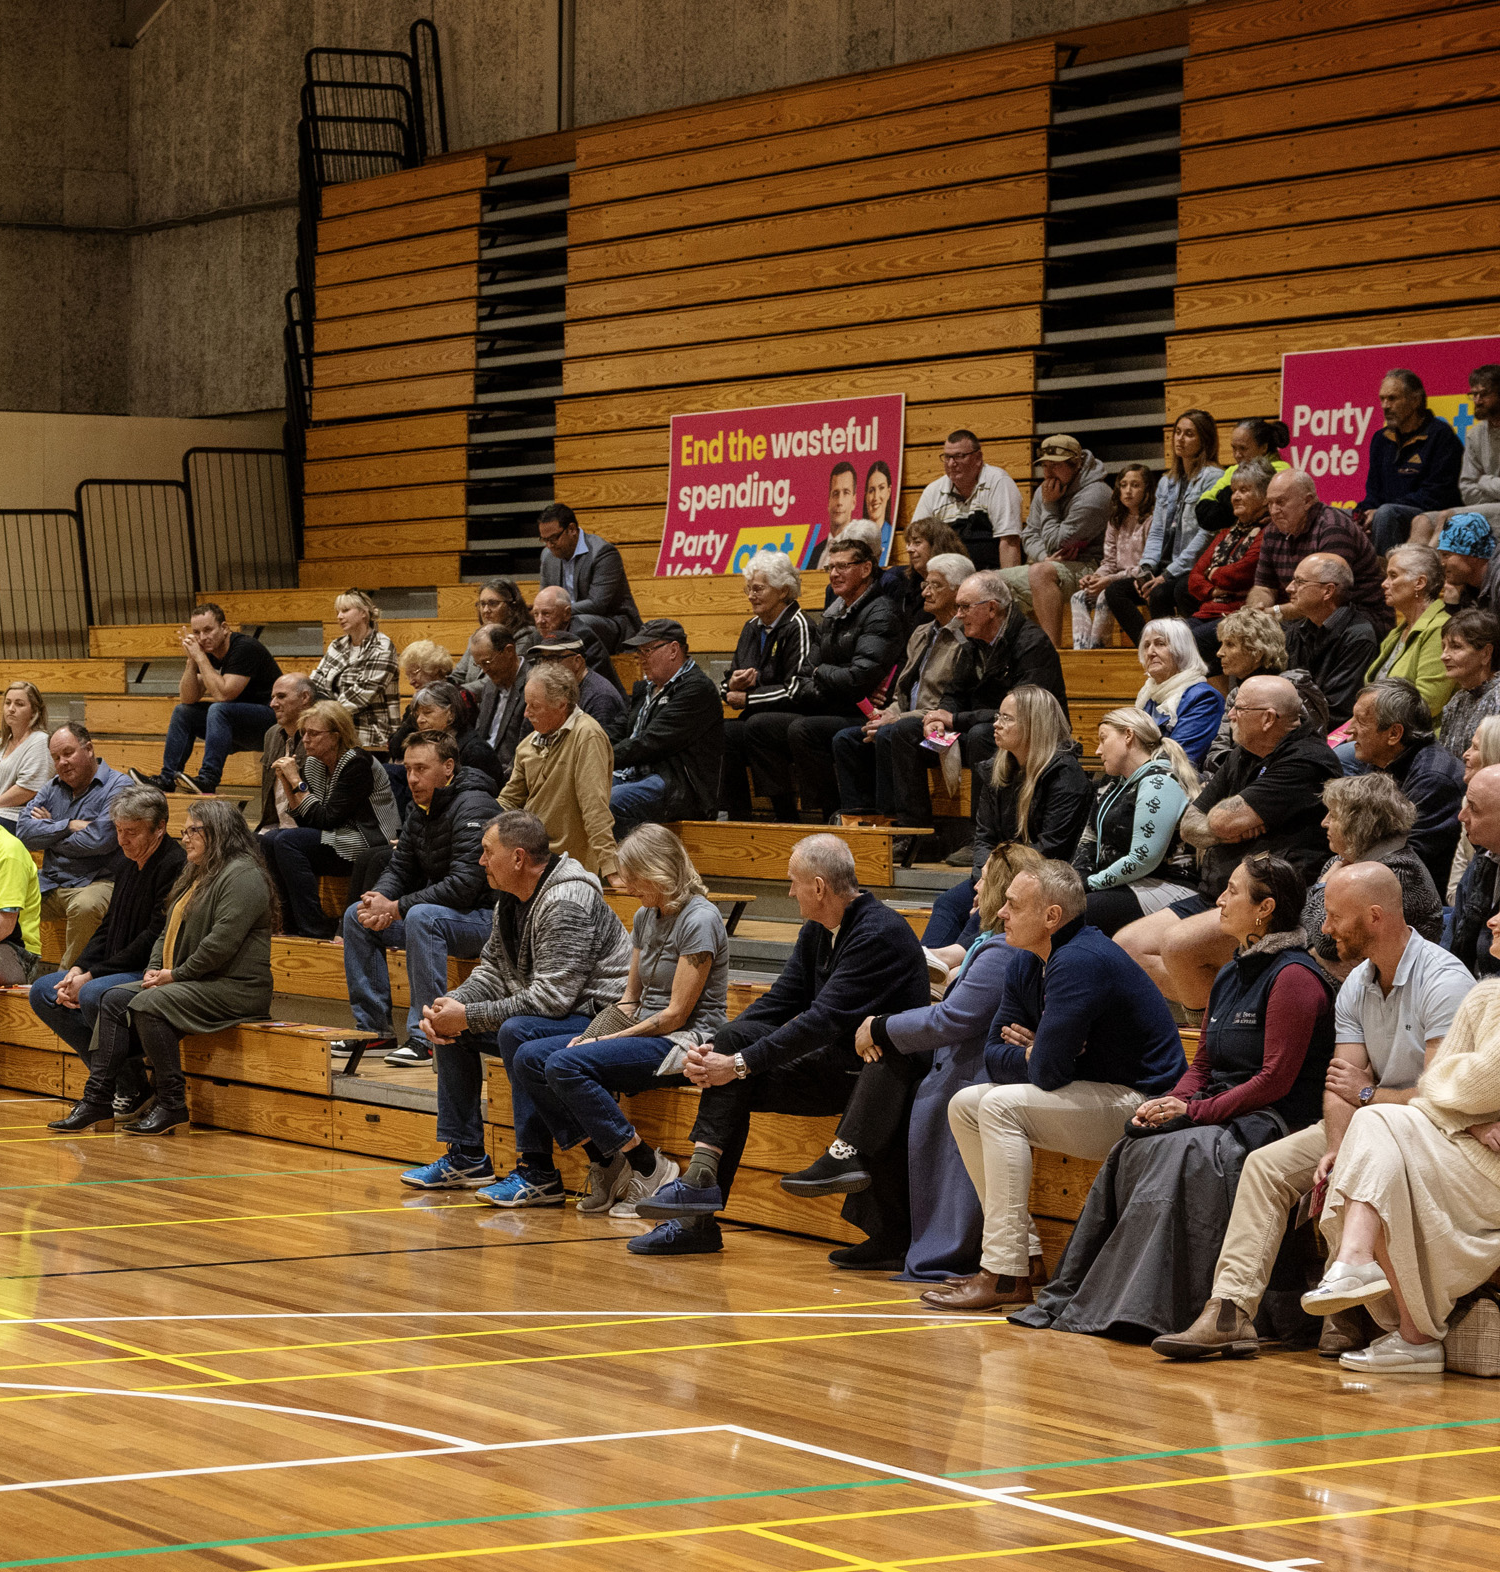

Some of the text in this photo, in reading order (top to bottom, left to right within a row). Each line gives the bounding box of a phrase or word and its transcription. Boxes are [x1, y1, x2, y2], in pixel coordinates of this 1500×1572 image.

[1292, 402, 1374, 445] Party
[681, 416, 878, 466] End the wasteful
[1290, 445, 1359, 477] Vote
[678, 471, 796, 522] spending.
[670, 529, 729, 565] Party
[733, 533, 795, 574] at
[1149, 775, 1164, 790] etc
[1145, 795, 1161, 814] etc
[1140, 820, 1156, 839] etc
[1134, 843, 1150, 861] etc
[1101, 873, 1117, 887] etc
[1121, 861, 1137, 876] etc
